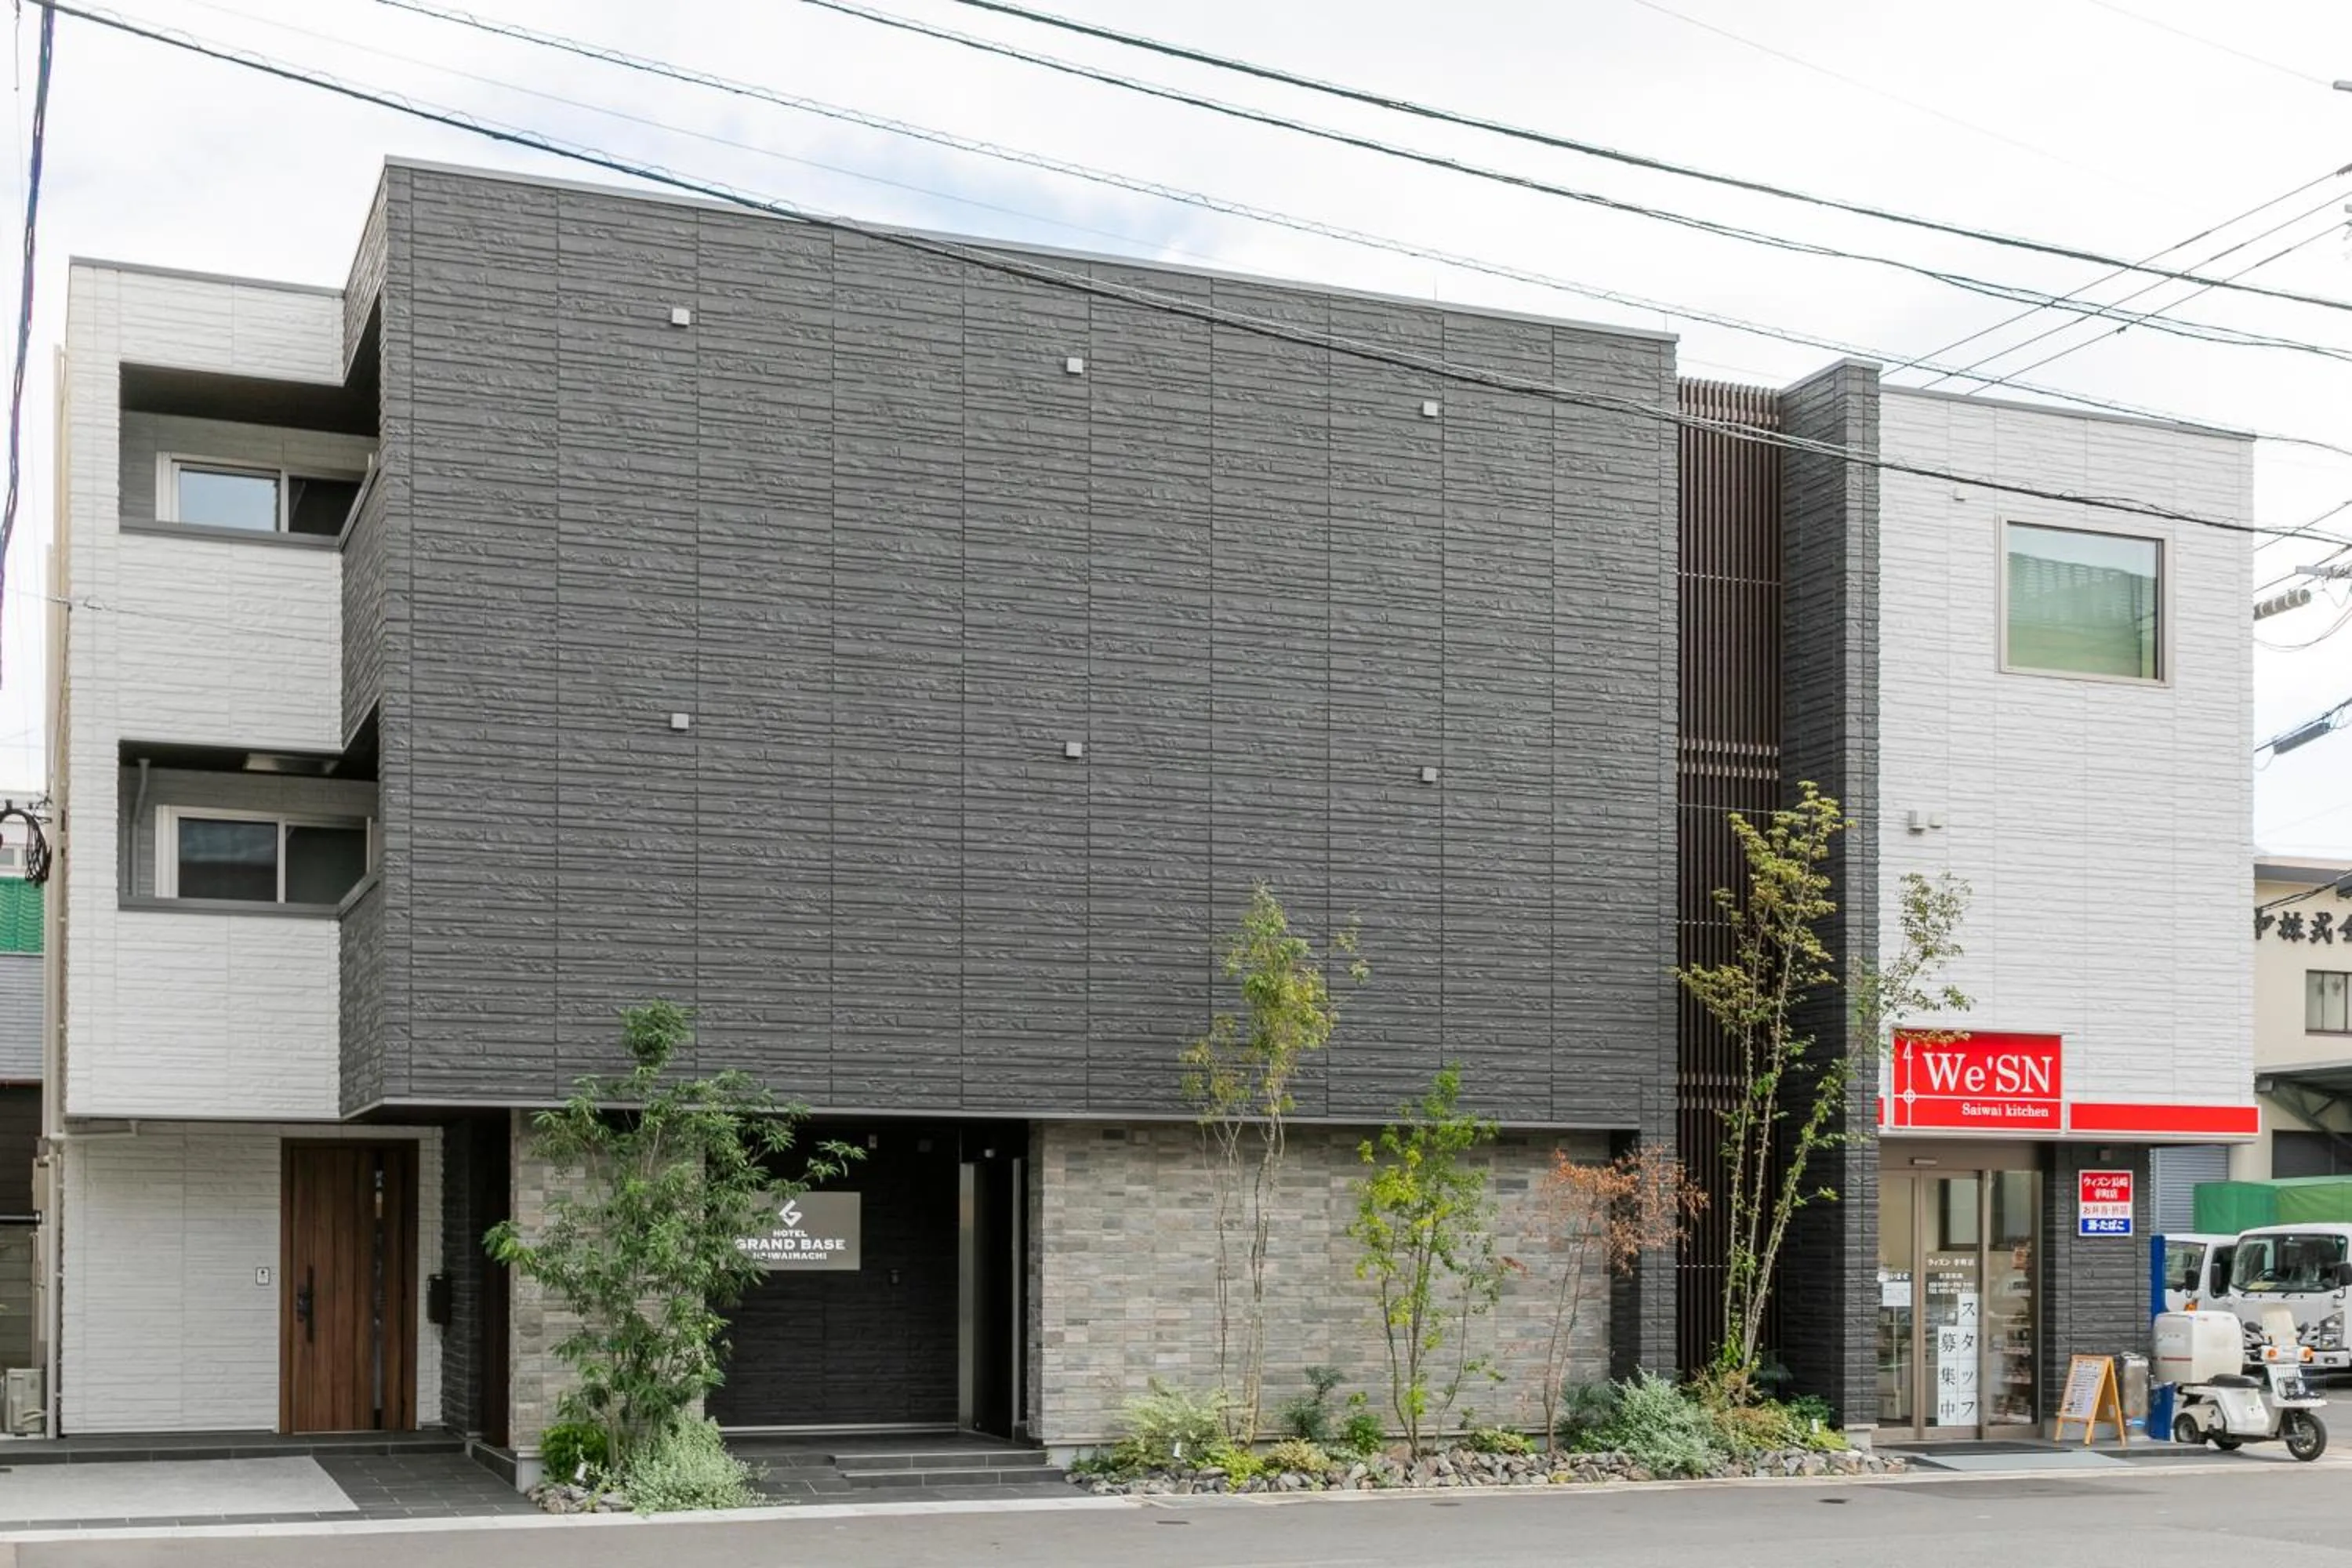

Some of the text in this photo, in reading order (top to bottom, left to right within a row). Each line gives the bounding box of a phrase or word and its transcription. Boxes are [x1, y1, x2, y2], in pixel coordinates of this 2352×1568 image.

[1922, 1052, 2053, 1094] We'SN
[1962, 1102, 2049, 1118] Saiwai kitchen
[735, 1238, 846, 1250] GRAND BASE
[772, 1229, 808, 1238] HOTEL
[1961, 1301, 1975, 1418] スタッフ
[1940, 1331, 1957, 1419] 募集中
